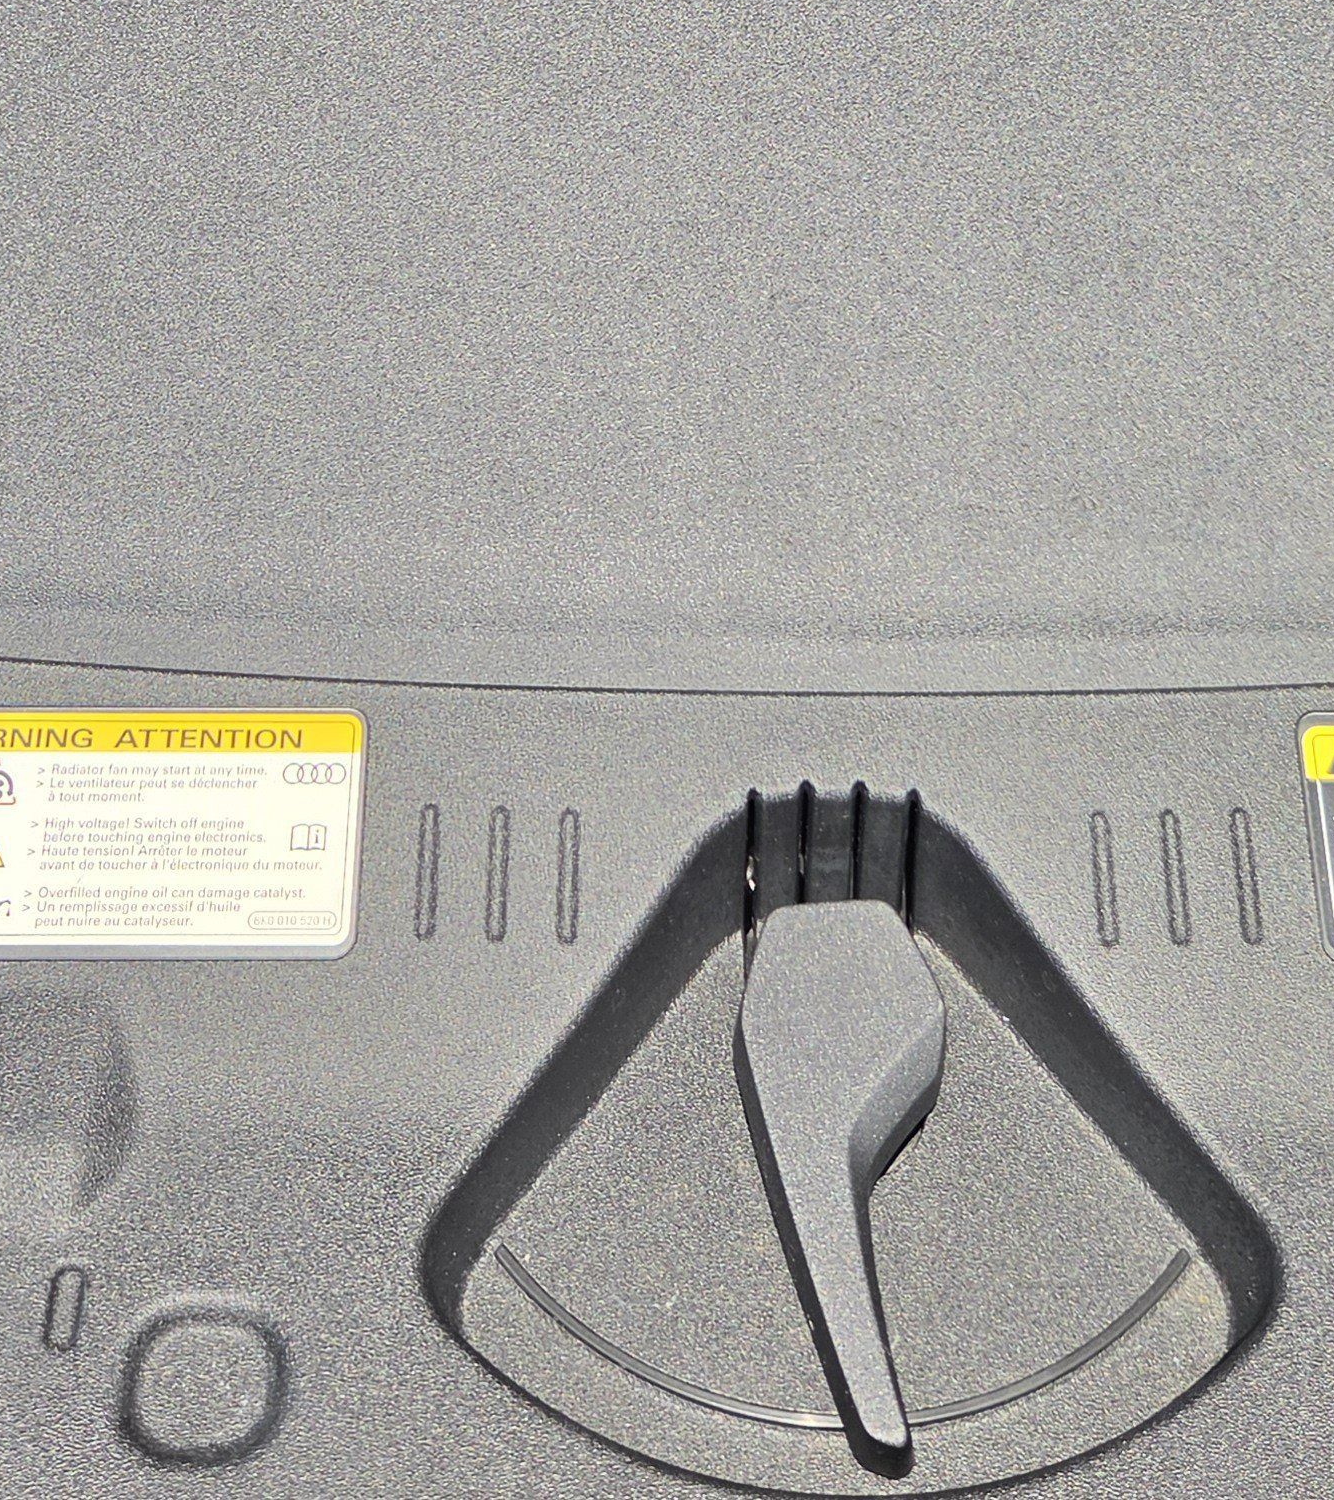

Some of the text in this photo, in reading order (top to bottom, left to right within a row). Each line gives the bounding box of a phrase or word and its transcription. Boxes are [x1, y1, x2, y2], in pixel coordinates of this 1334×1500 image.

[115, 728, 303, 749] ATTENTION
[51, 764, 267, 778] Radiator fan may start at any time.
[49, 778, 64, 788] Le
[69, 778, 135, 789] ventilateur
[139, 780, 167, 791] peut
[172, 780, 184, 789] se
[60, 792, 84, 802] tout
[88, 793, 144, 802] moment.
[45, 817, 74, 831] High
[134, 818, 176, 829] Switch
[181, 818, 198, 829] off
[201, 819, 244, 832] engine
[43, 830, 266, 844] before touching engine electronics.
[42, 845, 79, 856] Haute
[138, 844, 183, 856] Arrêter
[187, 846, 198, 857] le
[202, 847, 248, 857] moteur
[40, 860, 75, 870] avant
[79, 859, 94, 870] de
[98, 860, 147, 871] toucher
[253, 860, 270, 871] du
[274, 861, 322, 871] moteur.
[38, 887, 305, 901] Overfilled engine oil can damage catalyst.
[37, 902, 56, 912] Un
[60, 902, 138, 915] remplissage
[142, 902, 193, 912] excessif
[35, 916, 193, 929] peut nuire au catalyseur.
